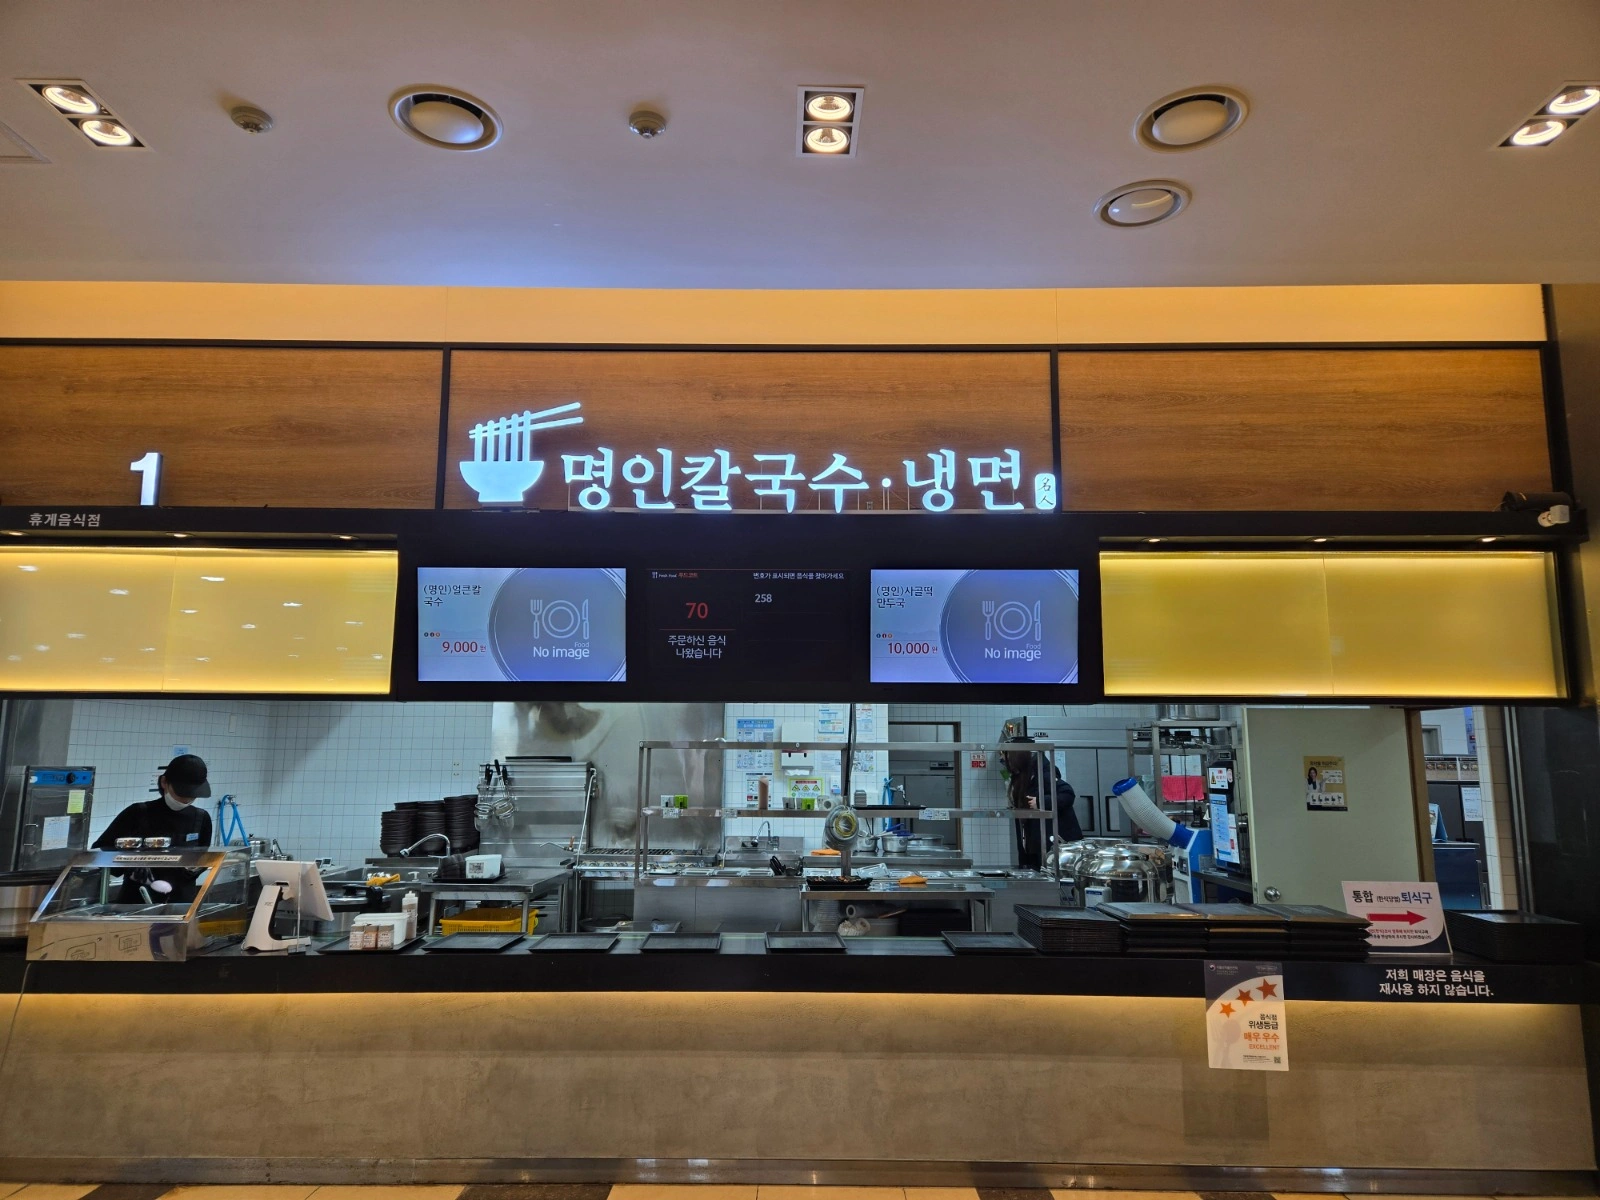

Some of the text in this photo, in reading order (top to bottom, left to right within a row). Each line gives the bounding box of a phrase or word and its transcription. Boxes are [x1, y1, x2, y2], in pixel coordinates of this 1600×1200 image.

[130, 452, 162, 506] 1
[28, 512, 101, 528] 휴게음식점
[753, 572, 771, 580] 번호가
[423, 584, 482, 596] (명인)얼큰칼
[876, 586, 933, 597] (명인)사골떡
[423, 597, 444, 607] 국수
[754, 593, 773, 603] 258
[876, 598, 906, 609] 만두국
[686, 602, 708, 619] 70
[668, 635, 726, 646] 주문하신 음식
[442, 641, 478, 654] 9,000
[533, 646, 590, 660] No image
[676, 648, 722, 659] 나왔습니다
[888, 642, 930, 655] 10,000
[985, 647, 1042, 661] No image
[1352, 890, 1374, 903] 통합
[1401, 891, 1432, 904] 퇴식구
[1386, 969, 1486, 983] 저희 매장은 음식을
[1379, 983, 1494, 997] 재사용 하지 않습니다.
[1260, 1013, 1278, 1021] 음식점
[1248, 1020, 1279, 1030] 위생등급
[1243, 1031, 1280, 1043] 매우 우수
[1248, 1043, 1280, 1051] EXCELLENT
